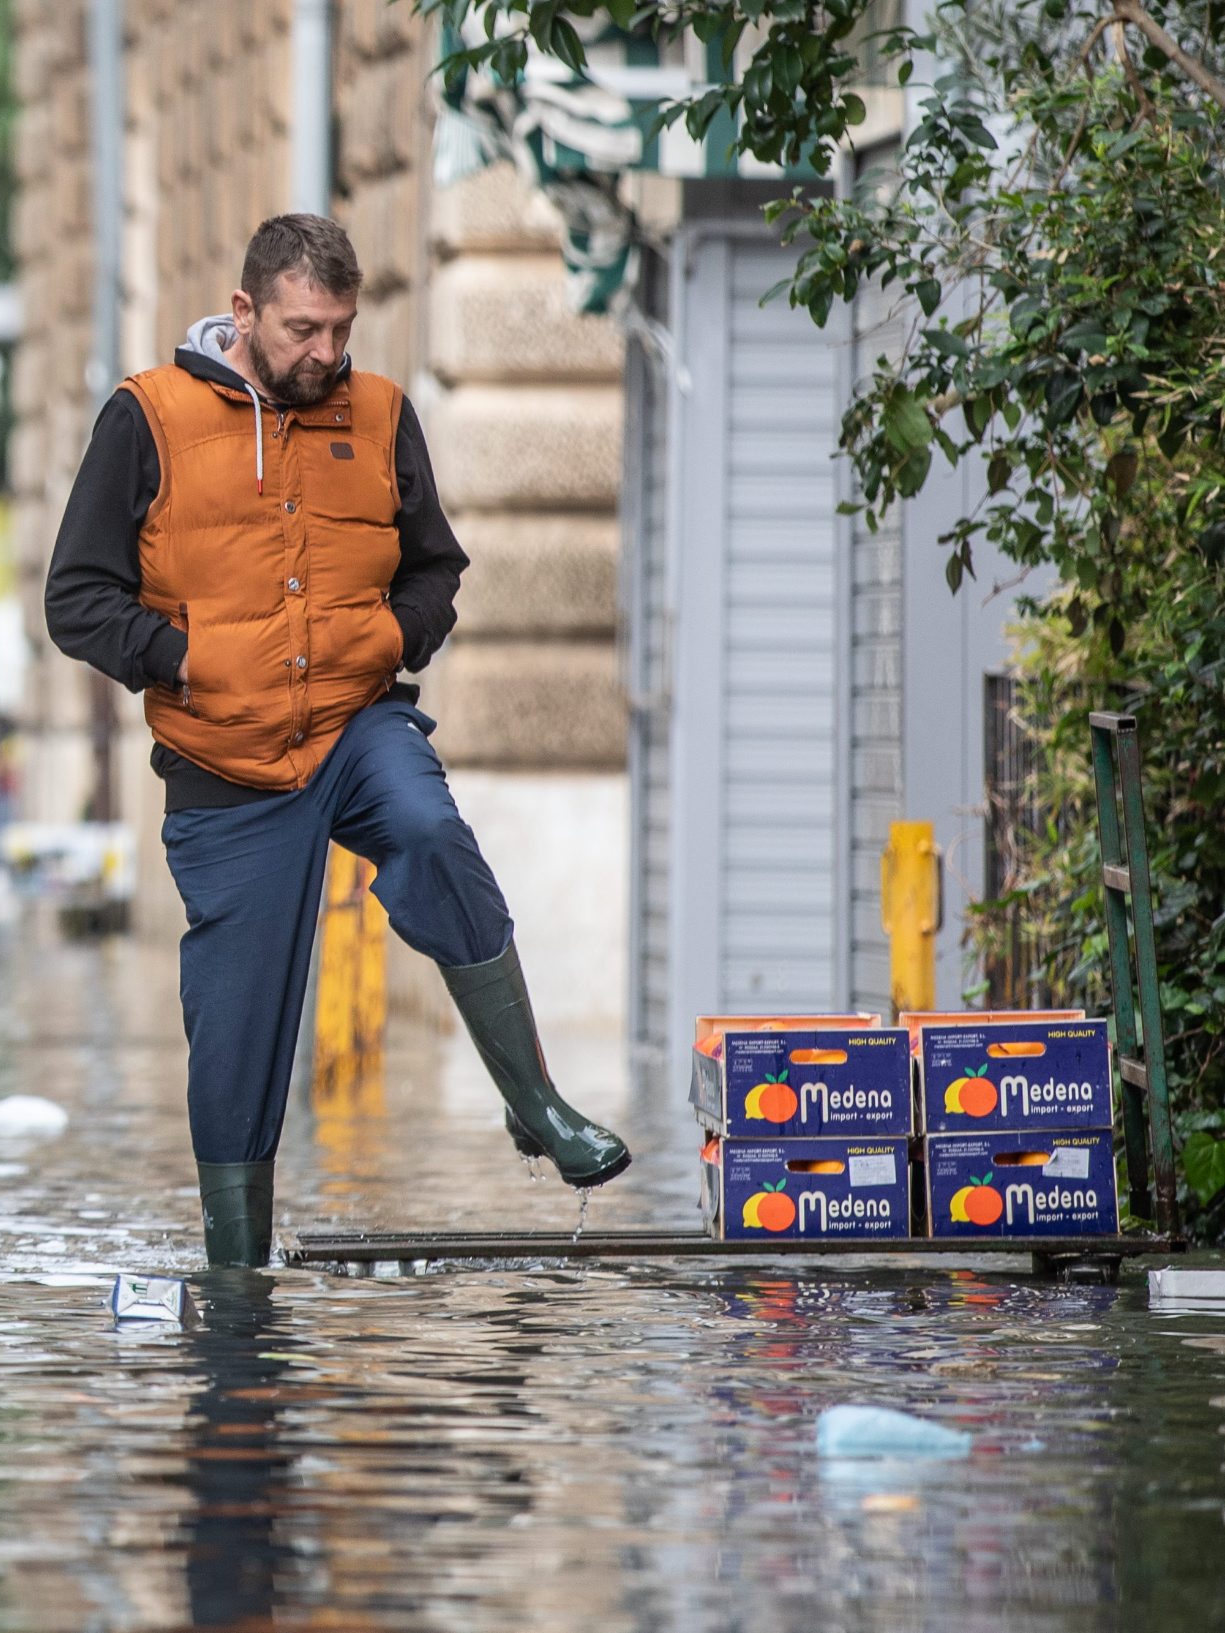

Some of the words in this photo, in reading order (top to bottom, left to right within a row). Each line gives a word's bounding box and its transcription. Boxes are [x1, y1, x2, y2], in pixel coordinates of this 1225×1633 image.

[1047, 1030, 1066, 1039] HIGH
[1067, 1029, 1096, 1038] QUALITY
[848, 1037, 866, 1046] HIGH
[868, 1036, 896, 1046] QUALITY
[1000, 1075, 1093, 1118] Medena
[800, 1082, 892, 1124] Medena
[1031, 1104, 1058, 1115] import
[1066, 1103, 1094, 1115] export
[830, 1111, 857, 1122] import
[866, 1111, 893, 1122] export
[1052, 1138, 1071, 1146] HIGH
[1072, 1137, 1100, 1146] QUALITY
[847, 1147, 865, 1155] HIGH
[866, 1146, 895, 1154] QUALITY
[1005, 1183, 1097, 1225] Medena
[798, 1190, 891, 1233] Medena
[1036, 1212, 1064, 1223] import
[1072, 1211, 1099, 1222] export
[828, 1221, 856, 1231] import
[864, 1220, 891, 1231] export
